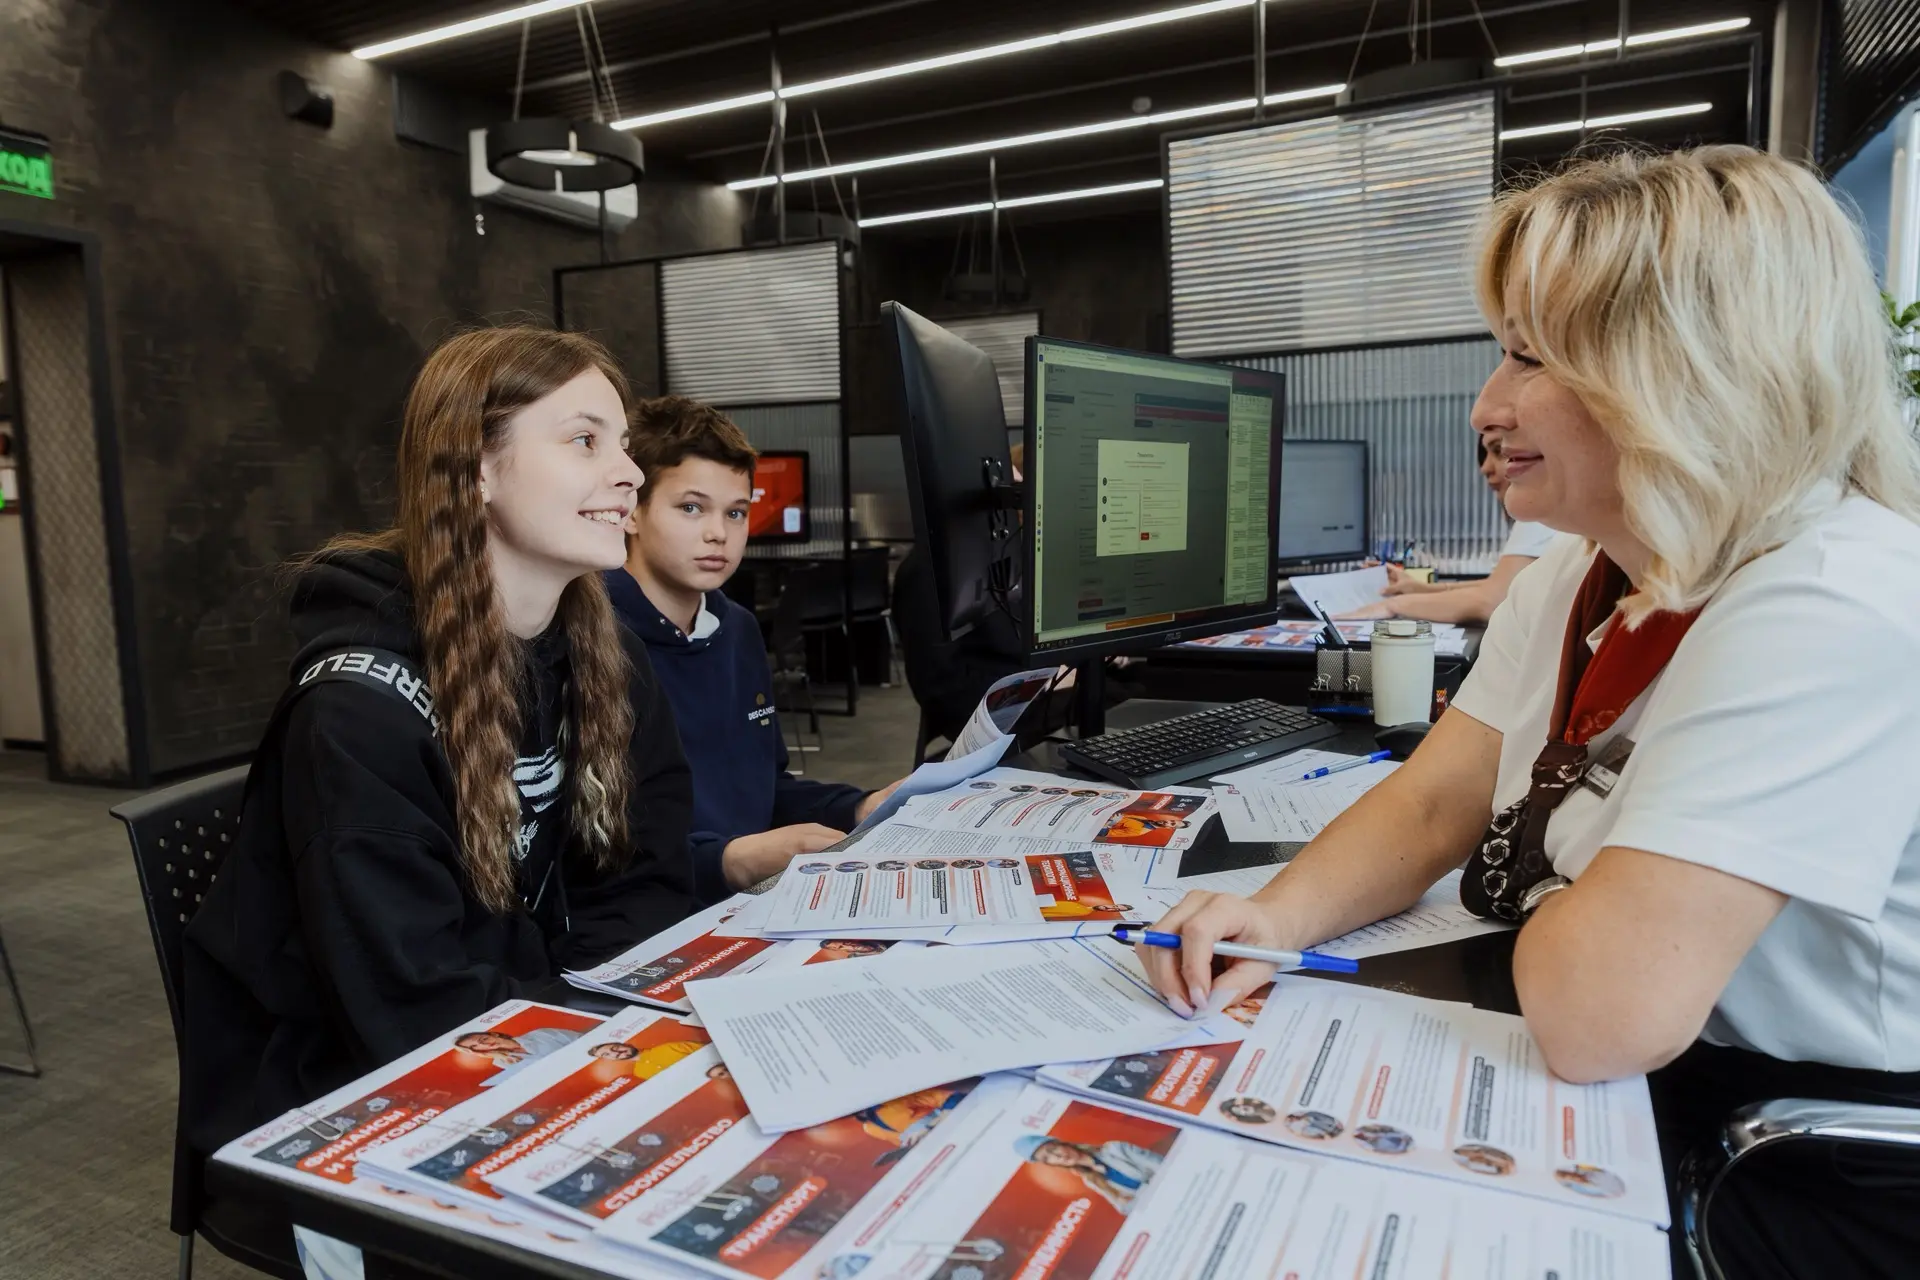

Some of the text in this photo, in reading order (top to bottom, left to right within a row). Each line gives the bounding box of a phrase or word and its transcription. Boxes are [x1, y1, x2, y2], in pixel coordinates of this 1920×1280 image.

[647, 939, 749, 996] ЗДРАВООХРАНЕНИЕ
[303, 1109, 407, 1168] ФИНАНСЫ
[472, 1075, 631, 1177] ИНФОРМАЦИОННЫЕ
[323, 1159, 346, 1175] И
[604, 1117, 734, 1211] СТРОИТЕЛЬСТВО
[723, 1180, 819, 1259] ТРАНСПОРТ
